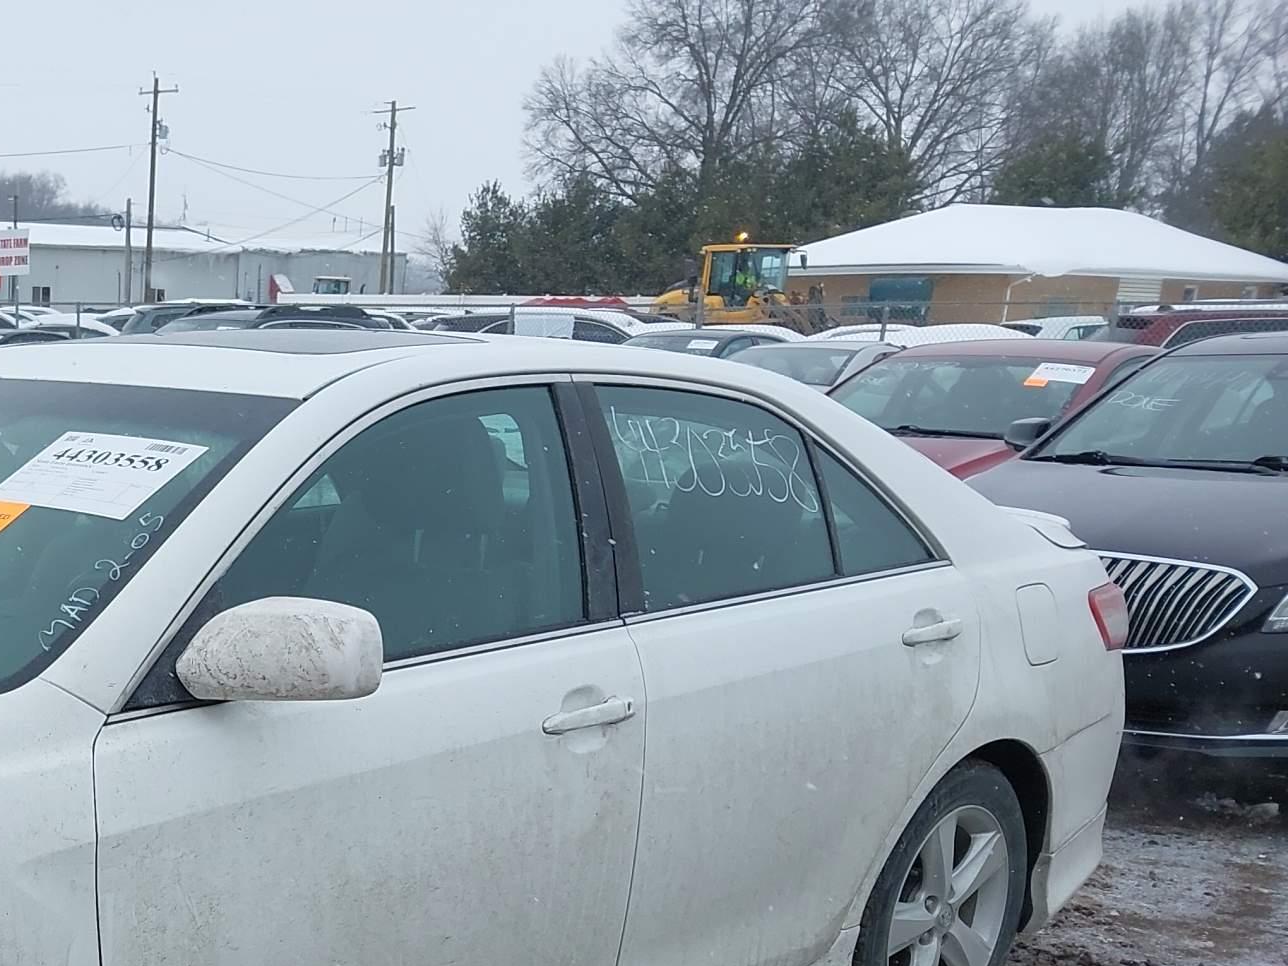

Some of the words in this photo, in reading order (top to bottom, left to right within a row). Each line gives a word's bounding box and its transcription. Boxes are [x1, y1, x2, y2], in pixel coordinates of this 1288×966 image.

[13, 238, 28, 248] FARM
[14, 255, 28, 266] ZONE
[53, 447, 169, 472] 44303558
[94, 512, 164, 581] 2-05
